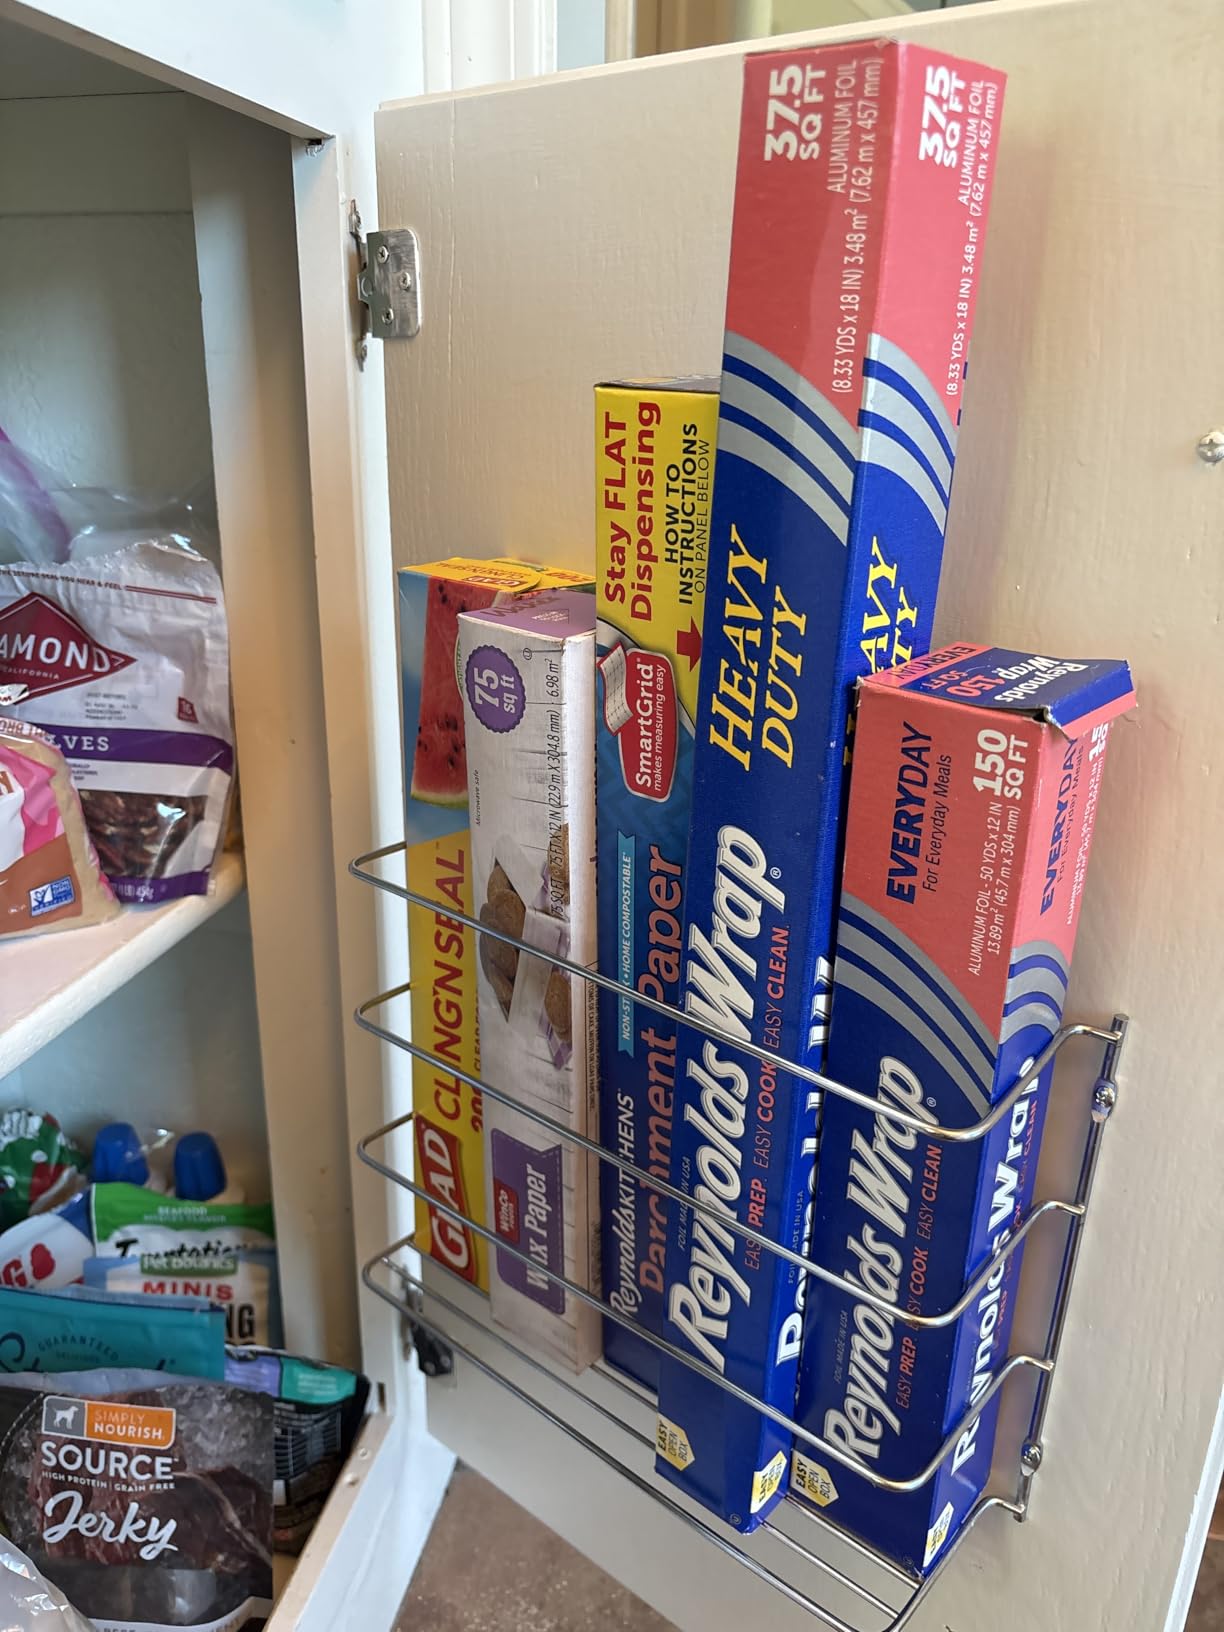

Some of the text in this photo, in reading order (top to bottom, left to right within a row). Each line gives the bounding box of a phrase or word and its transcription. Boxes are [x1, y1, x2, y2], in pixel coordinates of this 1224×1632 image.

[862, 57, 885, 96] mm)
[764, 65, 803, 161] 37.5
[800, 66, 827, 160] SQ FT
[827, 59, 857, 193] ALUMINUM FOIL
[857, 98, 879, 128] 457
[919, 65, 950, 163] 37.5
[942, 72, 967, 168] SQ FT
[958, 80, 985, 205] ALUMINUM FOIL
[979, 119, 993, 148] 457
[860, 145, 874, 164] m
[849, 167, 873, 203] (7.62
[975, 162, 986, 181] m
[969, 179, 985, 217] (7.62
[844, 233, 866, 266] 3.48
[961, 242, 976, 274] 3.48
[842, 264, 865, 291] IN)
[841, 294, 859, 312] 18
[955, 301, 968, 318] 18
[838, 326, 856, 355] YDS
[950, 331, 964, 360] YDS
[831, 358, 853, 393] (8.33
[945, 361, 961, 395] (8.33
[604, 411, 632, 605] Stay FLAT
[631, 401, 661, 622] Dispensing
[664, 463, 681, 564] HOW TO
[678, 423, 698, 605] INSTRUCTIONS
[694, 438, 711, 594] ON PANEL BELOW
[860, 535, 898, 673] AVY
[708, 523, 769, 772] HEAVY
[3, 666, 60, 680] CALIFORNIA
[762, 585, 807, 769] DUTY
[992, 655, 1062, 680] Wrap
[994, 661, 1089, 703] Reynolds
[473, 667, 499, 708] 75
[501, 674, 515, 714] sq ft
[546, 674, 560, 698] 6.98
[946, 674, 1006, 698] 150
[546, 709, 560, 733] mm)
[635, 662, 654, 788] SmartGrid
[652, 664, 667, 792] makes measuring easy
[547, 734, 560, 763] 304.8
[973, 728, 1008, 797] 150
[552, 773, 561, 784] m
[1002, 734, 1029, 800] SQ FT
[549, 809, 561, 821] IN
[549, 821, 562, 833] 12
[886, 721, 932, 904] EVERYDAY
[923, 754, 952, 892] For Everyday Meals
[1006, 805, 1021, 834] mm)
[1040, 737, 1078, 917] EVERYDAY
[550, 840, 562, 854] FT
[550, 854, 563, 867] 75
[1000, 833, 1015, 857] 304
[551, 877, 563, 889] FT
[1001, 866, 1011, 879] m
[968, 802, 1003, 976] ALUMINUM FOIL 50 YDS 12 IN
[994, 878, 1009, 907] (45.7
[987, 924, 1002, 955] 13.89
[622, 941, 632, 973] HOME
[767, 925, 788, 1000] CLEAN
[763, 1002, 779, 1049] EASY
[757, 1058, 778, 1122] COOK
[754, 1125, 771, 1169] EASY
[682, 1156, 691, 1180] USA
[525, 1163, 552, 1238] Paper
[668, 1040, 750, 1375] Reynolds
[748, 1178, 766, 1228] PREP
[678, 1229, 687, 1251] FOIL
[823, 1055, 939, 1460] Reynolds Wrap
[143, 1281, 234, 1301] MINIS
[896, 1144, 941, 1409] EASY PREP COOK EASY CLEAN
[841, 1310, 849, 1327] USA
[38, 1335, 119, 1361] GUARANTEED
[94, 1423, 162, 1439] NOURISH
[95, 1410, 145, 1424] SIMPLY
[657, 1420, 669, 1449] EASY
[666, 1431, 678, 1459] OPEN
[678, 1439, 688, 1462] BOX
[41, 1440, 174, 1480] SOURCE
[795, 1458, 807, 1487] EASY
[41, 1471, 176, 1492] HIGH PROTEIN GRAIN FREE
[807, 1470, 819, 1493] OPEN
[820, 1477, 832, 1499] BOX
[42, 1490, 179, 1560] Jerky
